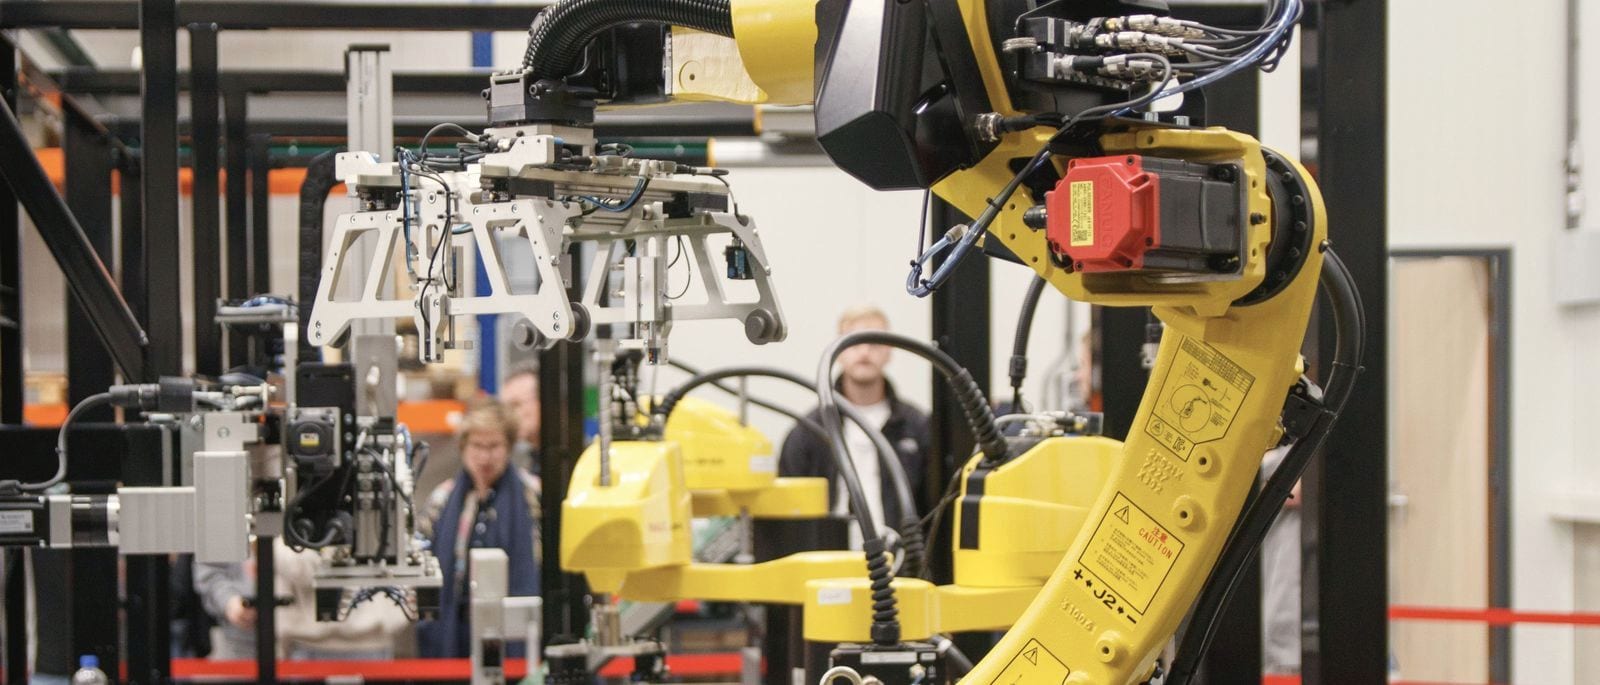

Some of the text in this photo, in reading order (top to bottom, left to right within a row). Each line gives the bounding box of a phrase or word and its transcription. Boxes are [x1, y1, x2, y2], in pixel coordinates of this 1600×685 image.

[1101, 176, 1114, 248] FANUC
[1138, 527, 1173, 559] CAUTION
[1093, 589, 1117, 610] J2
